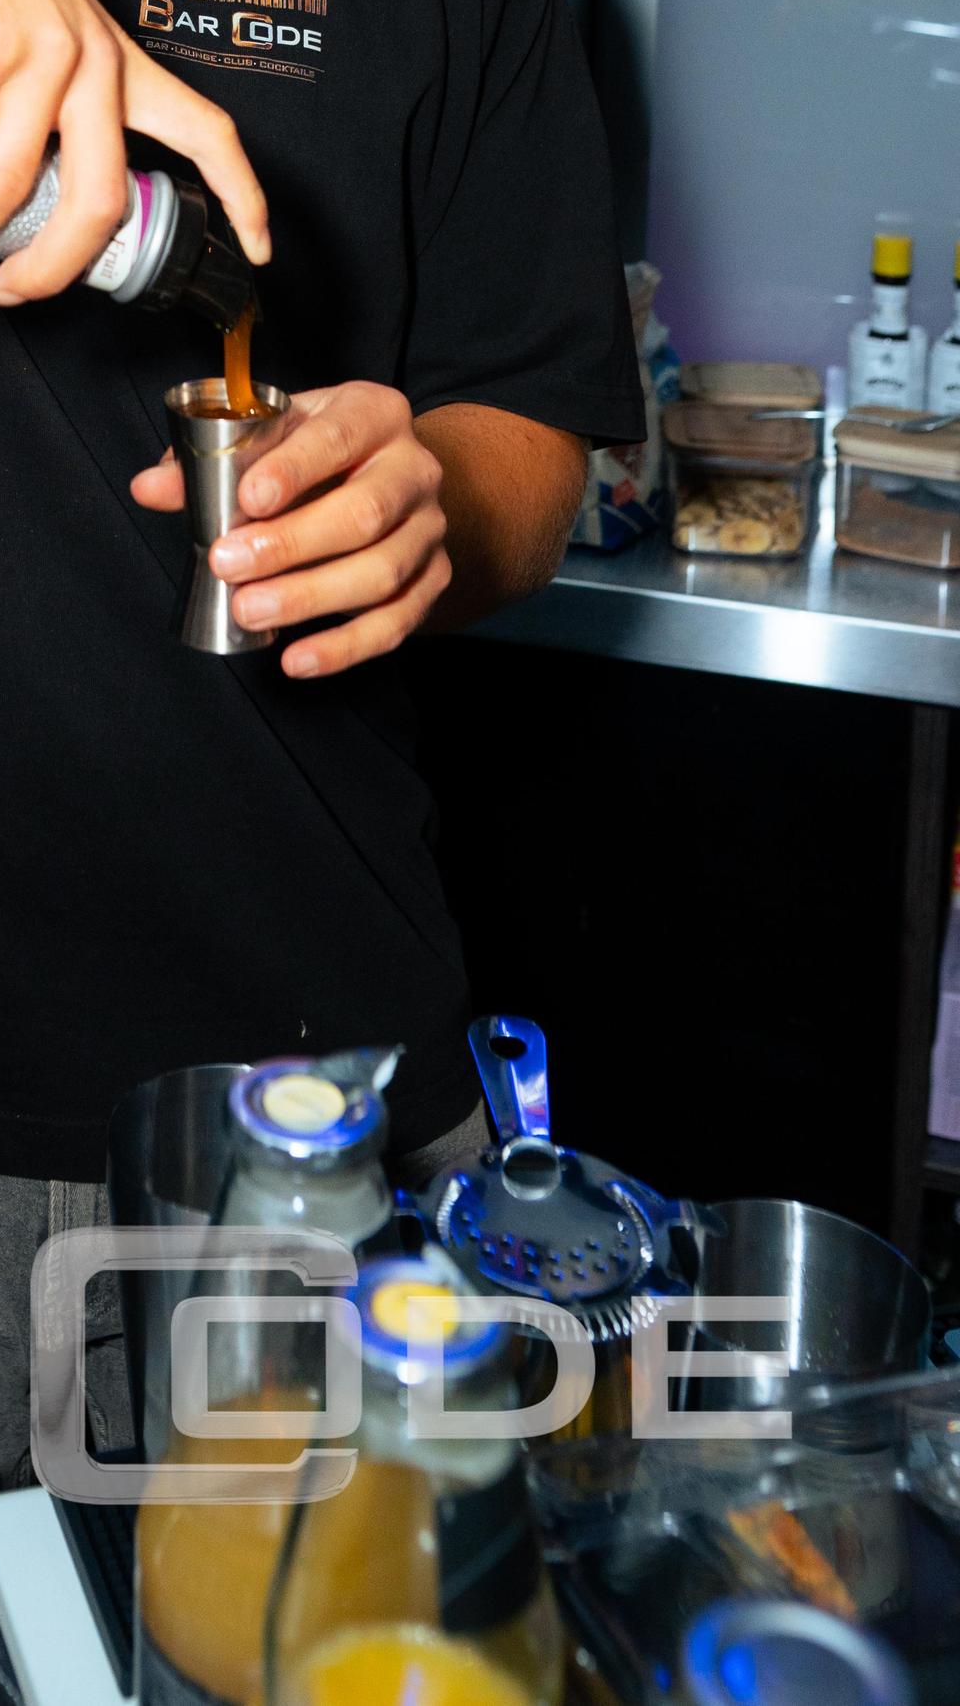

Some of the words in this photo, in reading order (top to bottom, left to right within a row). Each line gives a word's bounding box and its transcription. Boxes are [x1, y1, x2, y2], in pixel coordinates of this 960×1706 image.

[146, 40, 169, 51] BAR
[174, 47, 217, 63] LOUNGE
[223, 53, 253, 67] CLUB
[259, 60, 315, 78] COCKTAILS
